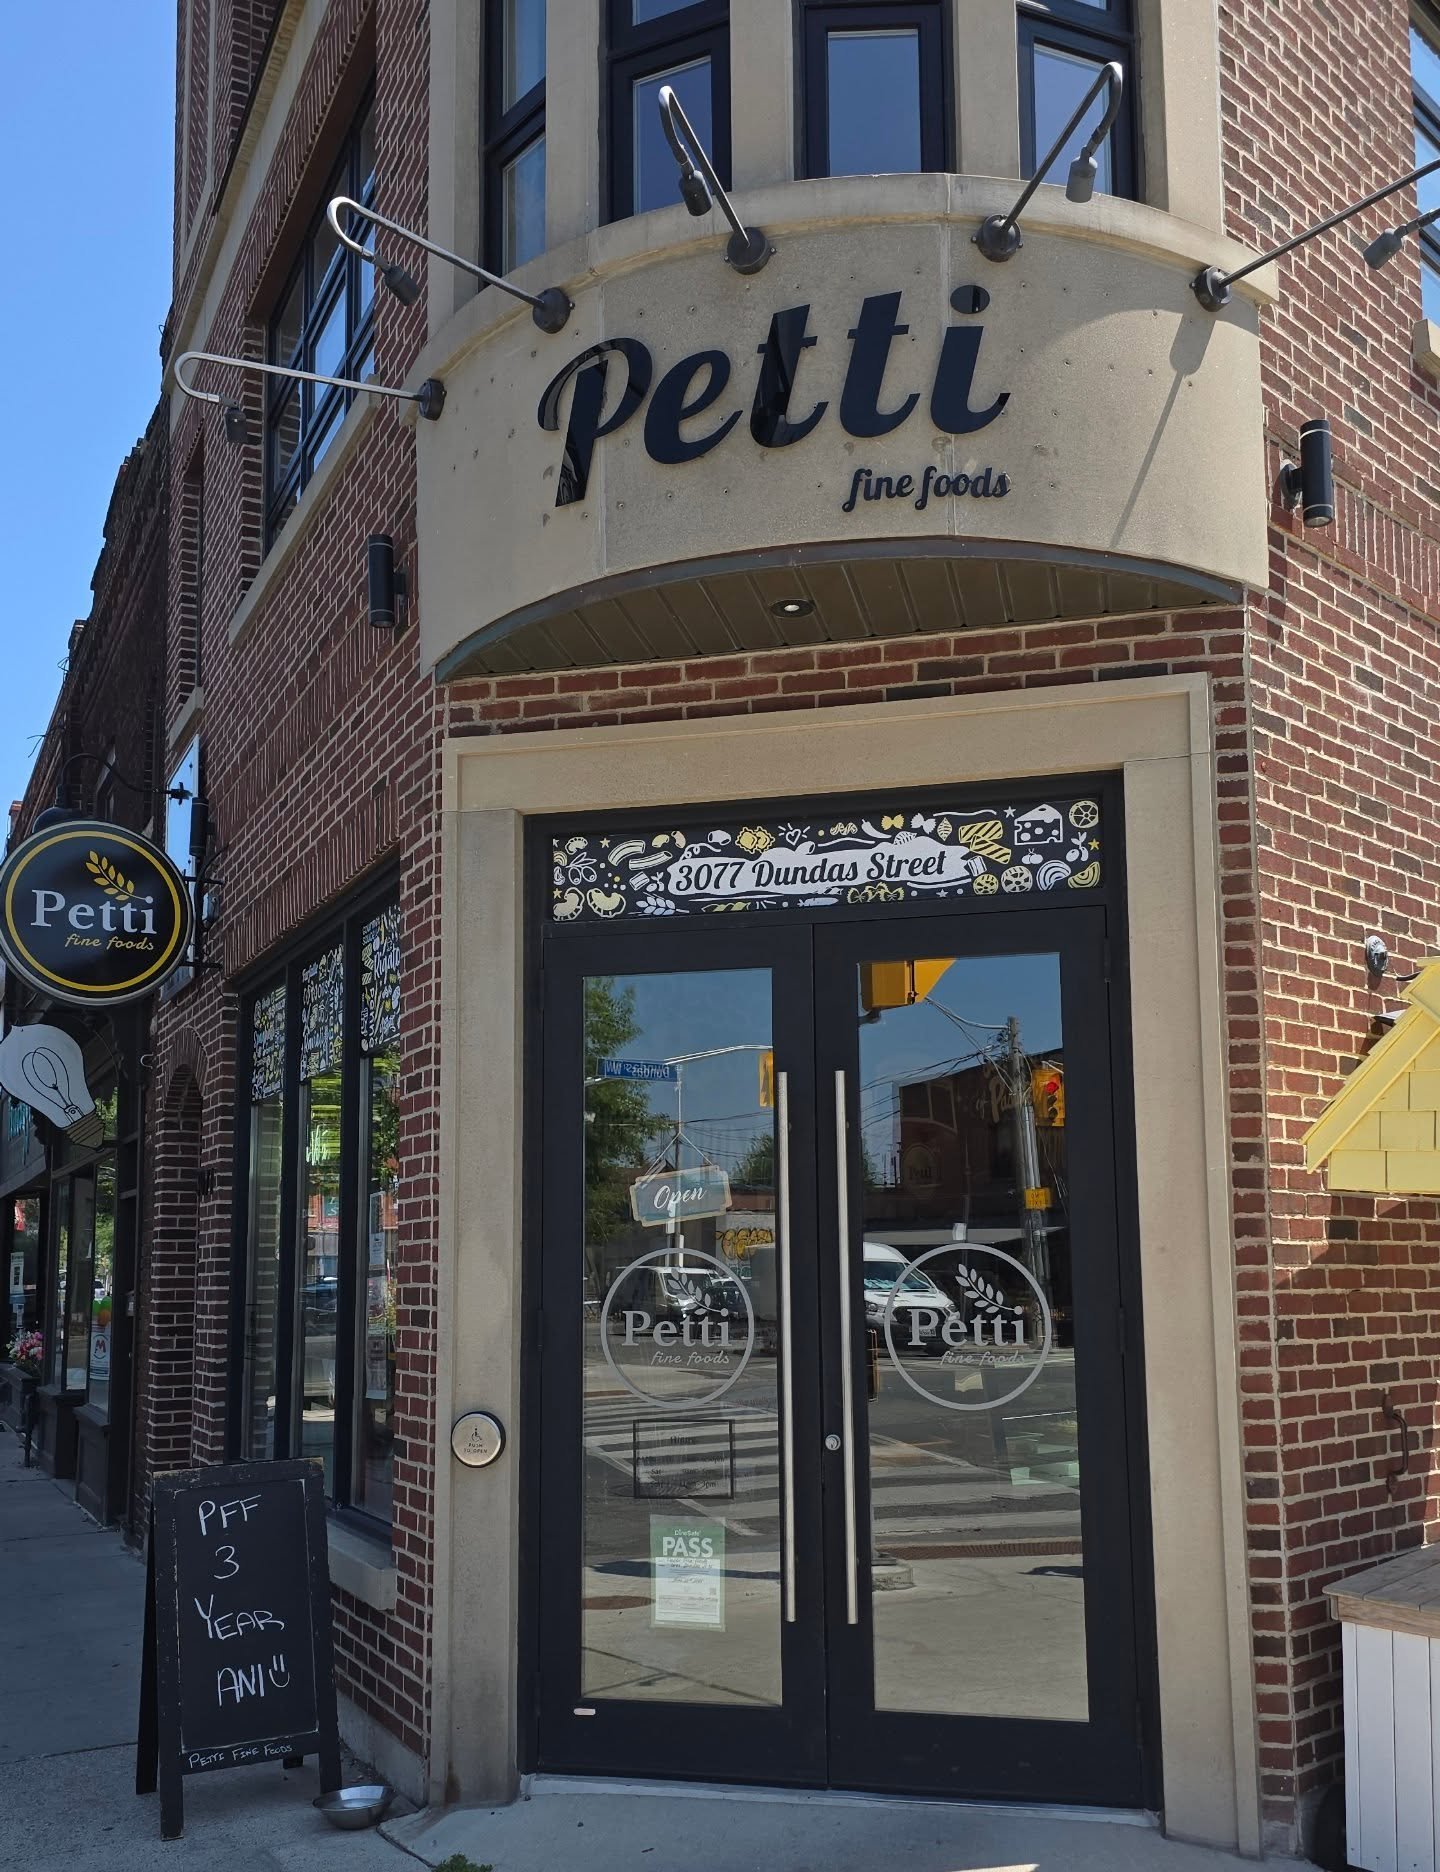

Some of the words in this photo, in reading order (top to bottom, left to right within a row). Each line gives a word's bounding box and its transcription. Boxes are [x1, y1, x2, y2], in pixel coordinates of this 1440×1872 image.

[538, 284, 1011, 508] Petti
[842, 467, 914, 513] fine
[914, 466, 1011, 511] foods
[676, 862, 745, 891] 3077
[752, 855, 858, 888] Dundas
[866, 851, 948, 882] Street
[31, 890, 157, 934] Petti
[65, 933, 101, 947] fine
[106, 936, 154, 950] foods
[653, 1184, 707, 1212] Open
[622, 1308, 732, 1347] Petti
[907, 1305, 1027, 1347] Petti
[651, 1350, 682, 1365] fine
[687, 1350, 730, 1366] foods
[938, 1350, 976, 1365] fine
[978, 1350, 1025, 1365] foods
[198, 1494, 262, 1536] PFF
[213, 1544, 240, 1579] 3
[662, 1536, 714, 1558] PASS
[194, 1594, 285, 1640] YEAR
[217, 1663, 265, 1706] ANI
